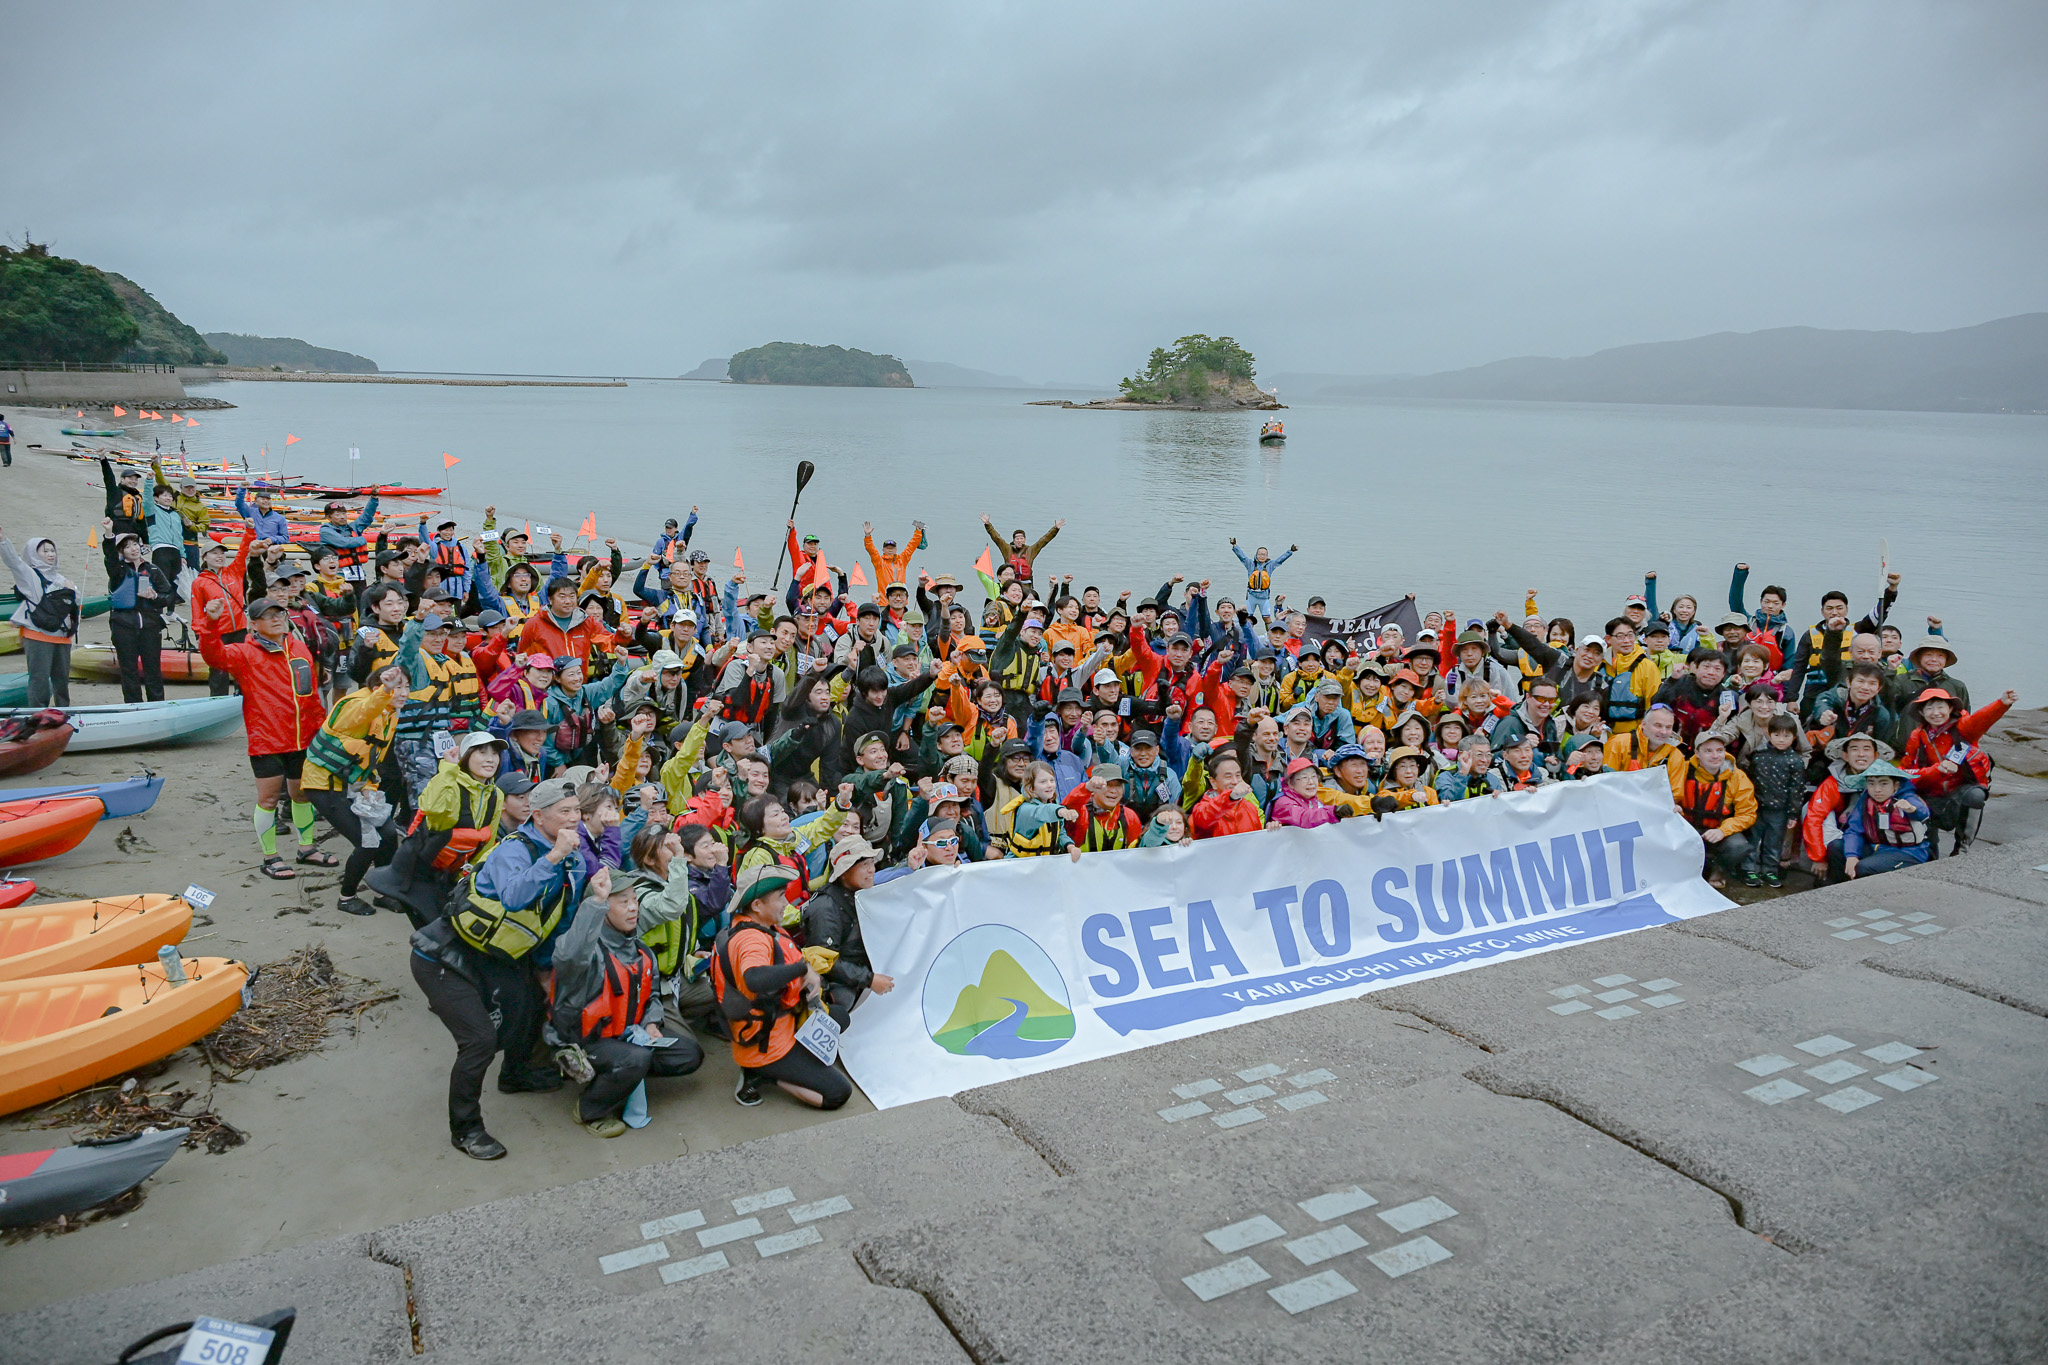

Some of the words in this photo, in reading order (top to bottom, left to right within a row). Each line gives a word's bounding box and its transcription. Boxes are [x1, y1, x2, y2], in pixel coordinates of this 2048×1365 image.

[1329, 615, 1382, 634] TEAM
[191, 889, 208, 901] 301
[1081, 899, 1249, 998] SEA
[1252, 878, 1352, 968] TO
[1371, 820, 1644, 944] SUMMIT
[1221, 961, 1400, 1002] YAMAGUCHI
[811, 1027, 836, 1053] 029
[199, 1338, 250, 1365] 508
